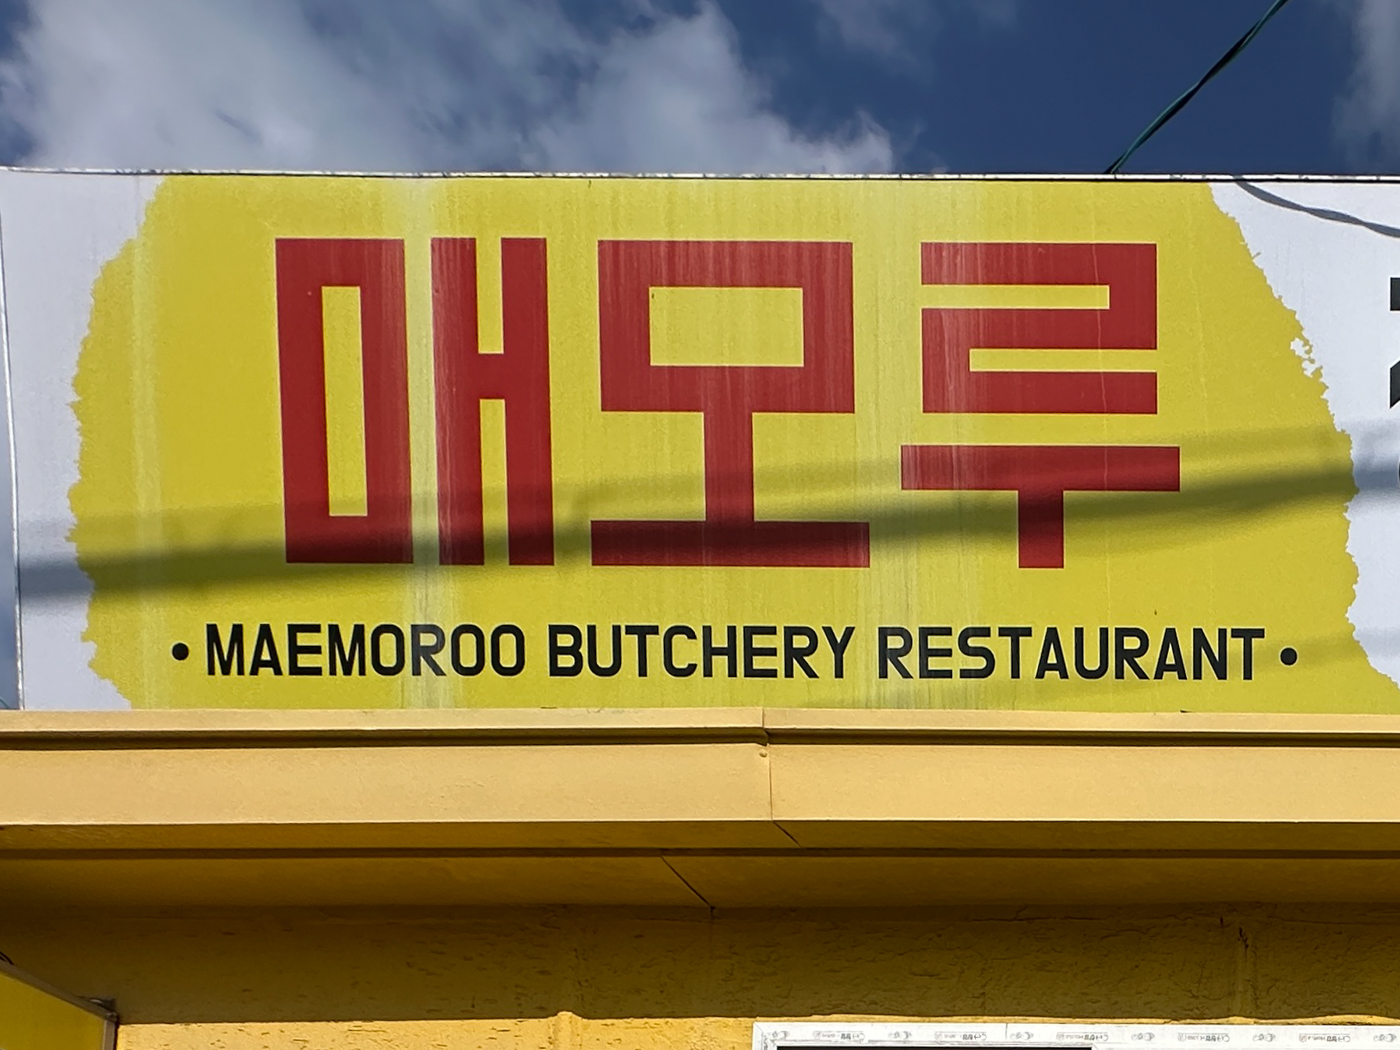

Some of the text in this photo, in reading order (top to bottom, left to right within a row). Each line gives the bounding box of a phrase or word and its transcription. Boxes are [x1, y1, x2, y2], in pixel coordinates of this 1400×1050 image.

[275, 237, 1180, 568] 매모루
[206, 623, 1266, 681] MAEMOROO BUTCHERY RESTAURANT
